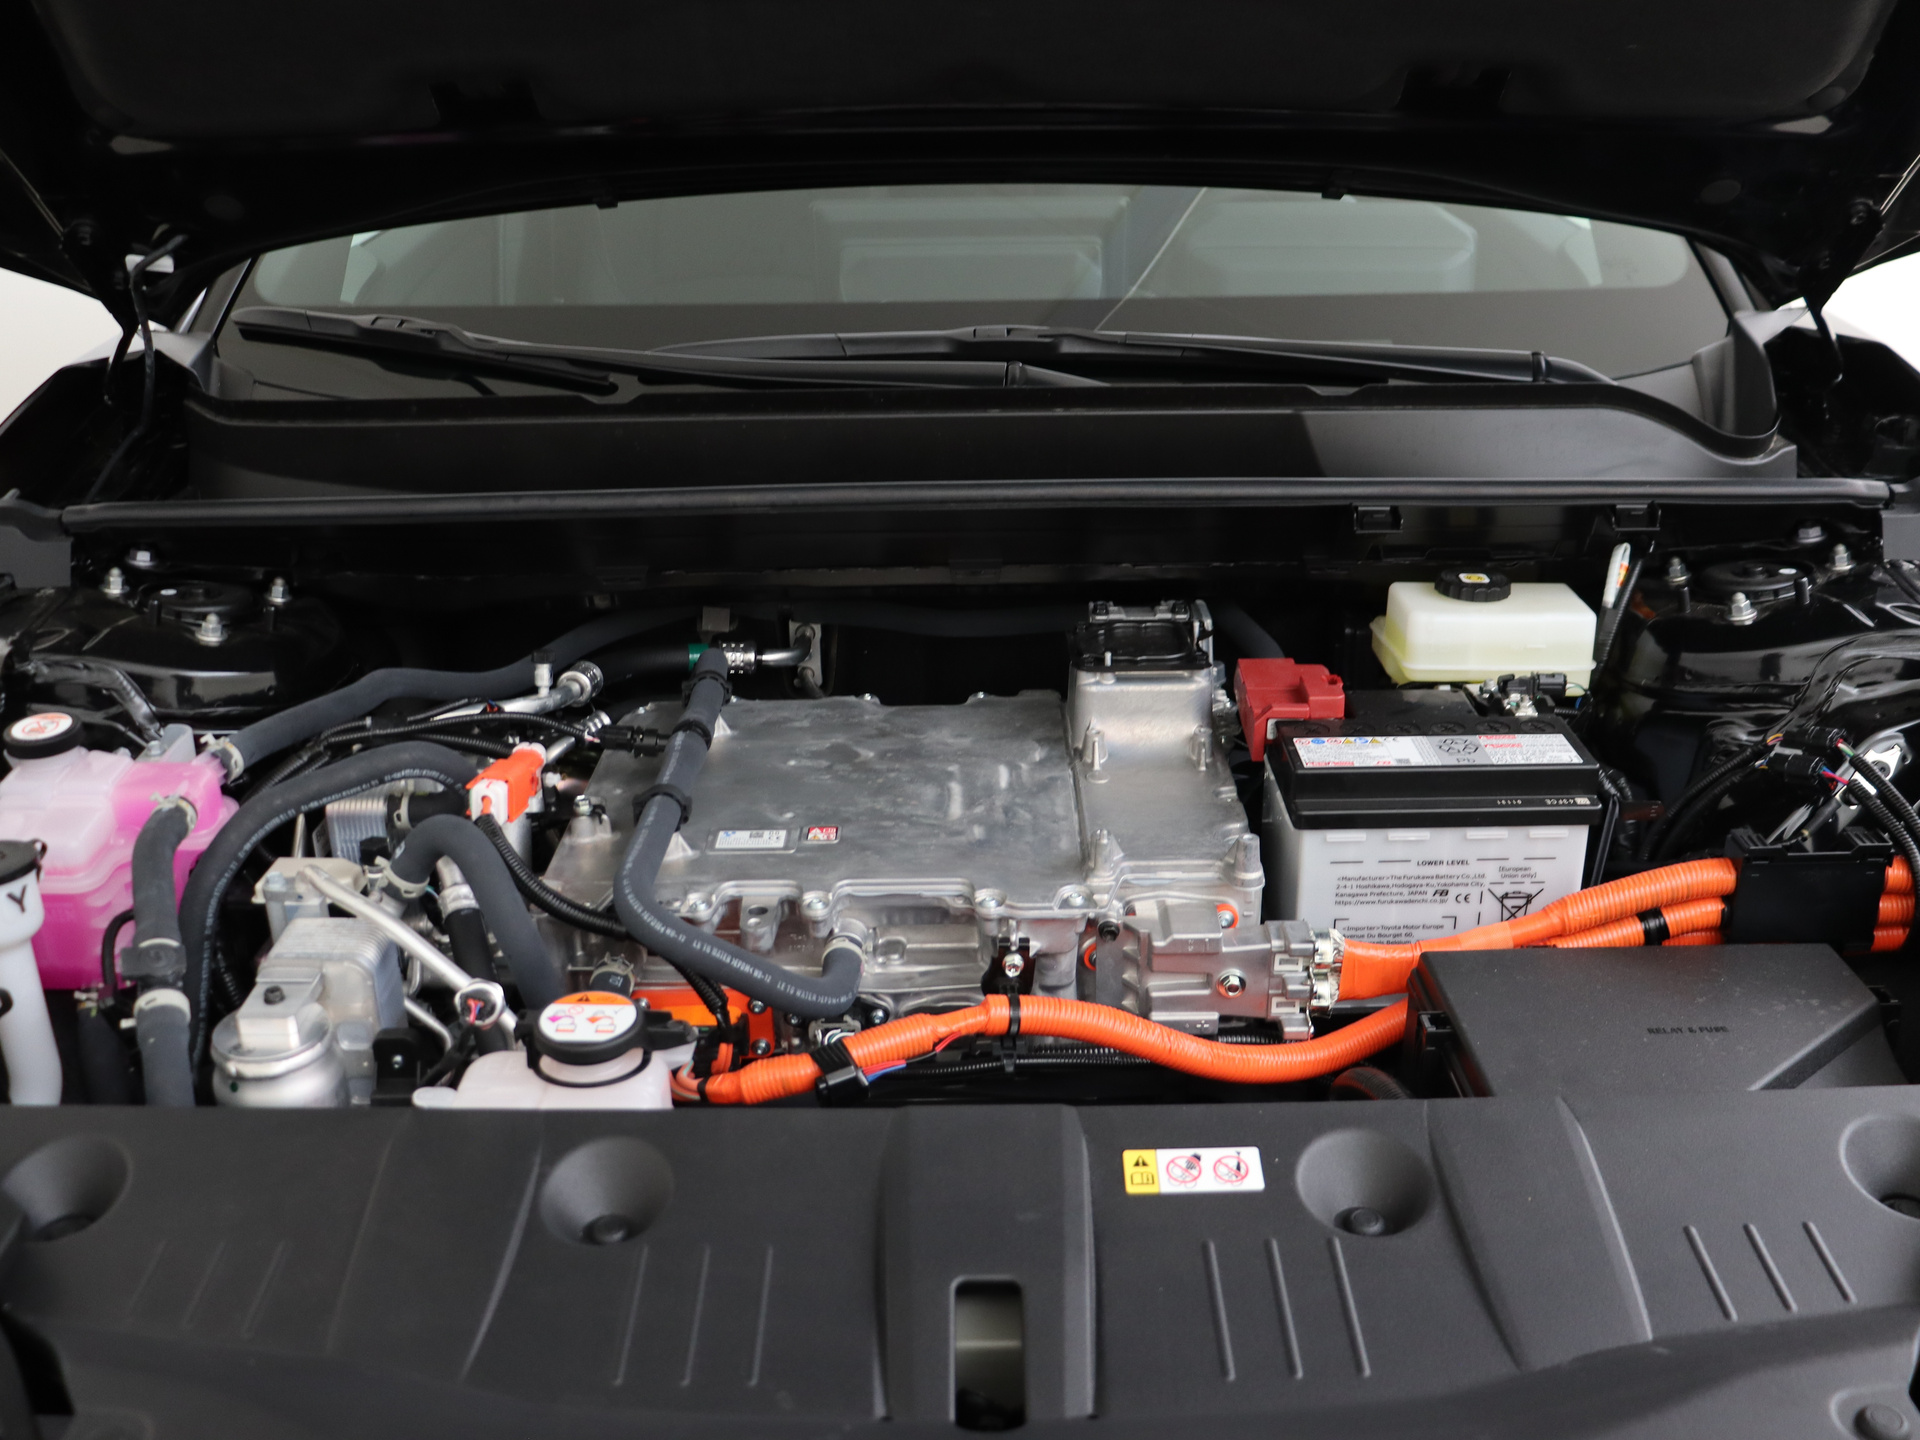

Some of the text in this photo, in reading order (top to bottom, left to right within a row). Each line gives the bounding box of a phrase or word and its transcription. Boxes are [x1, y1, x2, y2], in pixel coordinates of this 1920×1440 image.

[1416, 859, 1444, 867] LOWER
[1370, 890, 1406, 898] Prefecture,
[796, 989, 817, 1002] WATER
